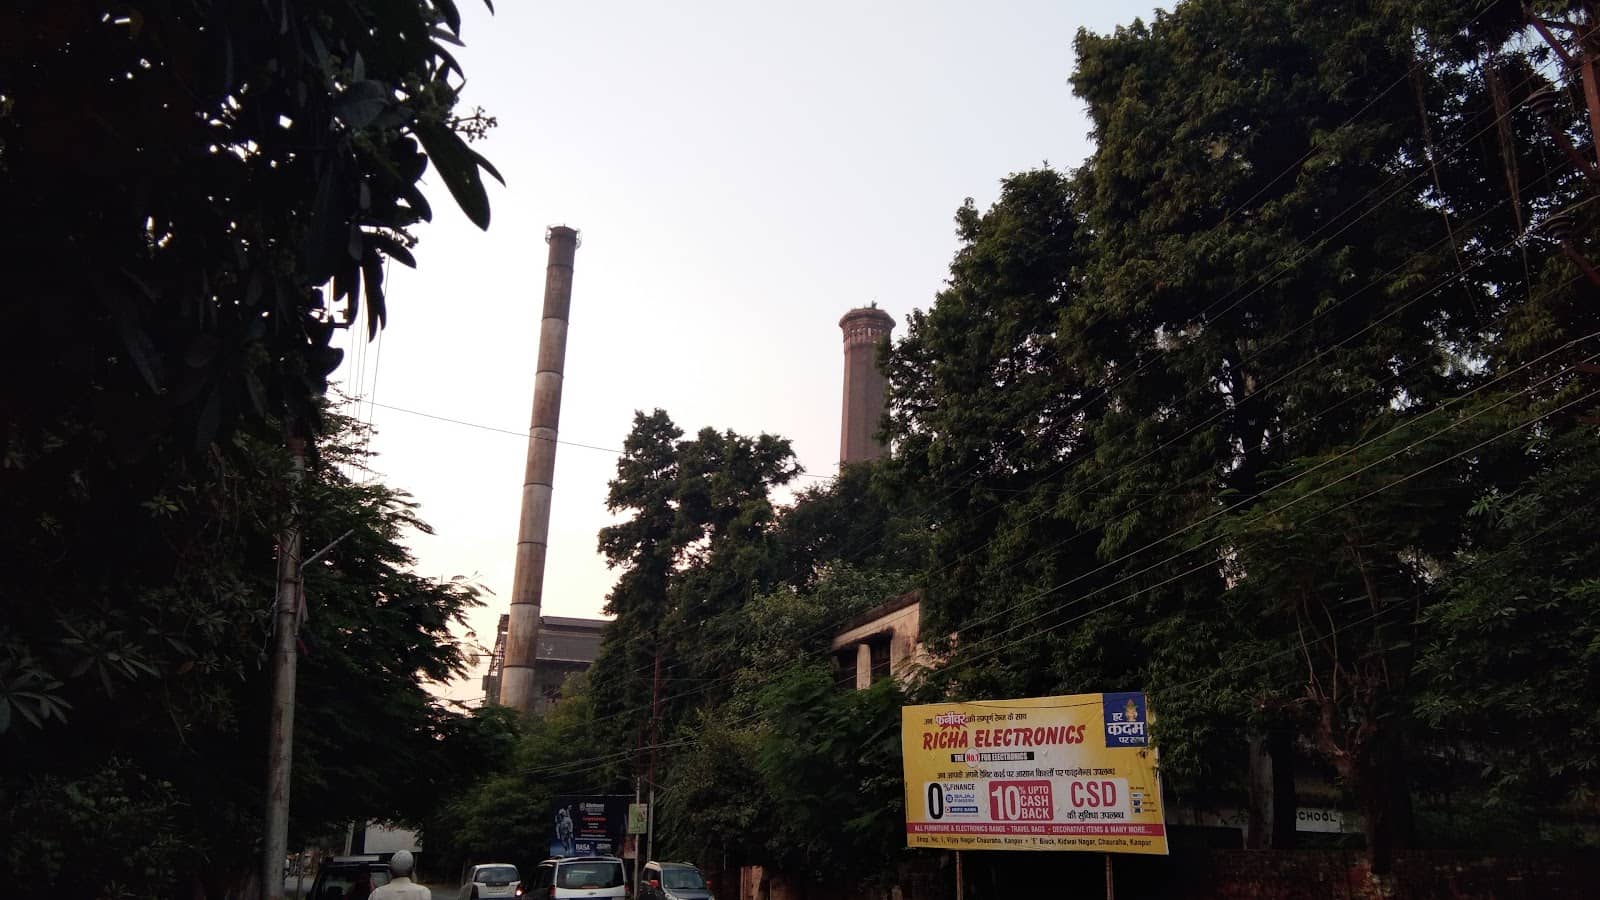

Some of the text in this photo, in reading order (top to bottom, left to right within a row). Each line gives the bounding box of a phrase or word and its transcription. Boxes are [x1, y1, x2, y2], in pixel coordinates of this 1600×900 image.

[1112, 712, 1123, 721] हर
[1107, 721, 1144, 736] कदम
[923, 725, 1086, 751] RICHA ELECTRONICS
[1118, 736, 1130, 744] पर
[1055, 769, 1064, 777] पर
[950, 783, 976, 791] FINANCE
[1028, 786, 1049, 794] UPTO
[1070, 781, 1117, 807] CSD
[1021, 795, 1049, 807] CASH
[1021, 807, 1050, 819] BACK
[1067, 809, 1076, 819] की
[1078, 810, 1099, 822] सुविधा
[1296, 811, 1336, 822] CHOOL
[956, 825, 988, 833] ELECTRONICS
[1011, 825, 1030, 833] TRAVEL
[1130, 839, 1152, 848] Kanpur
